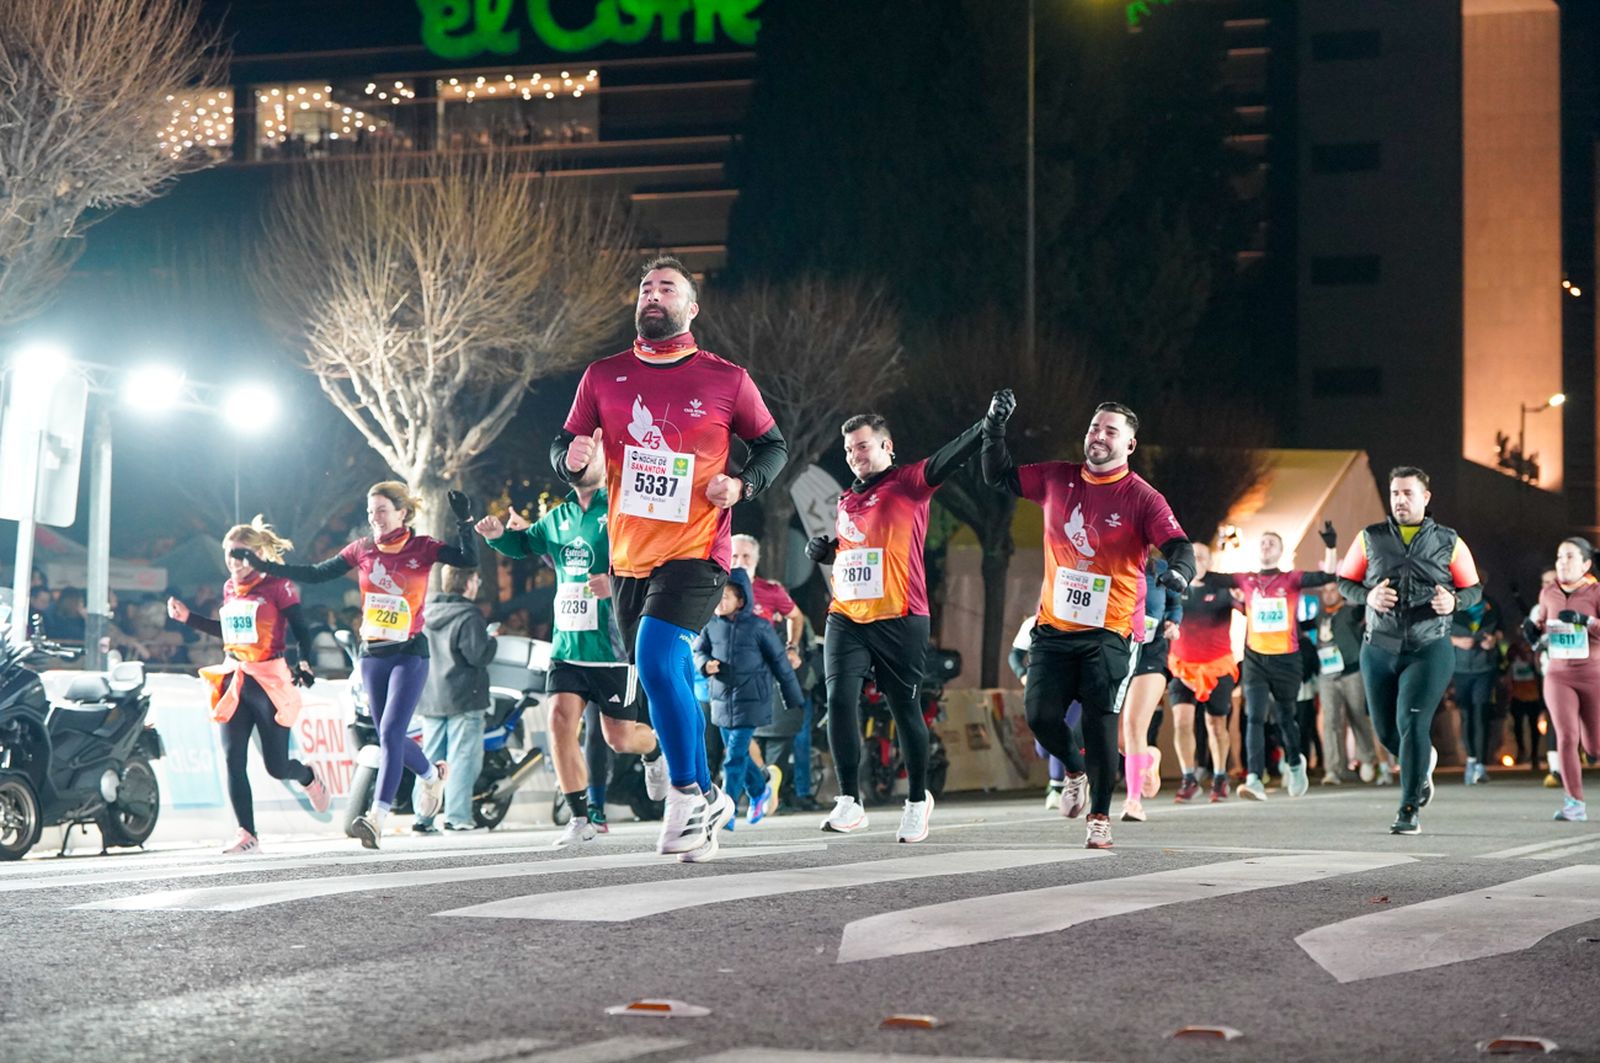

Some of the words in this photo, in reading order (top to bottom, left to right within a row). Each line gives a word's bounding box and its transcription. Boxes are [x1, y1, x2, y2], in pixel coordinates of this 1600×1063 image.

[642, 431, 661, 450] 43
[631, 462, 643, 471] SAN
[634, 472, 679, 497] 5337
[842, 566, 871, 582] 2870
[1066, 587, 1092, 607] 798
[561, 599, 588, 615] 2239
[376, 609, 399, 625] 226
[301, 719, 344, 753] SAN
